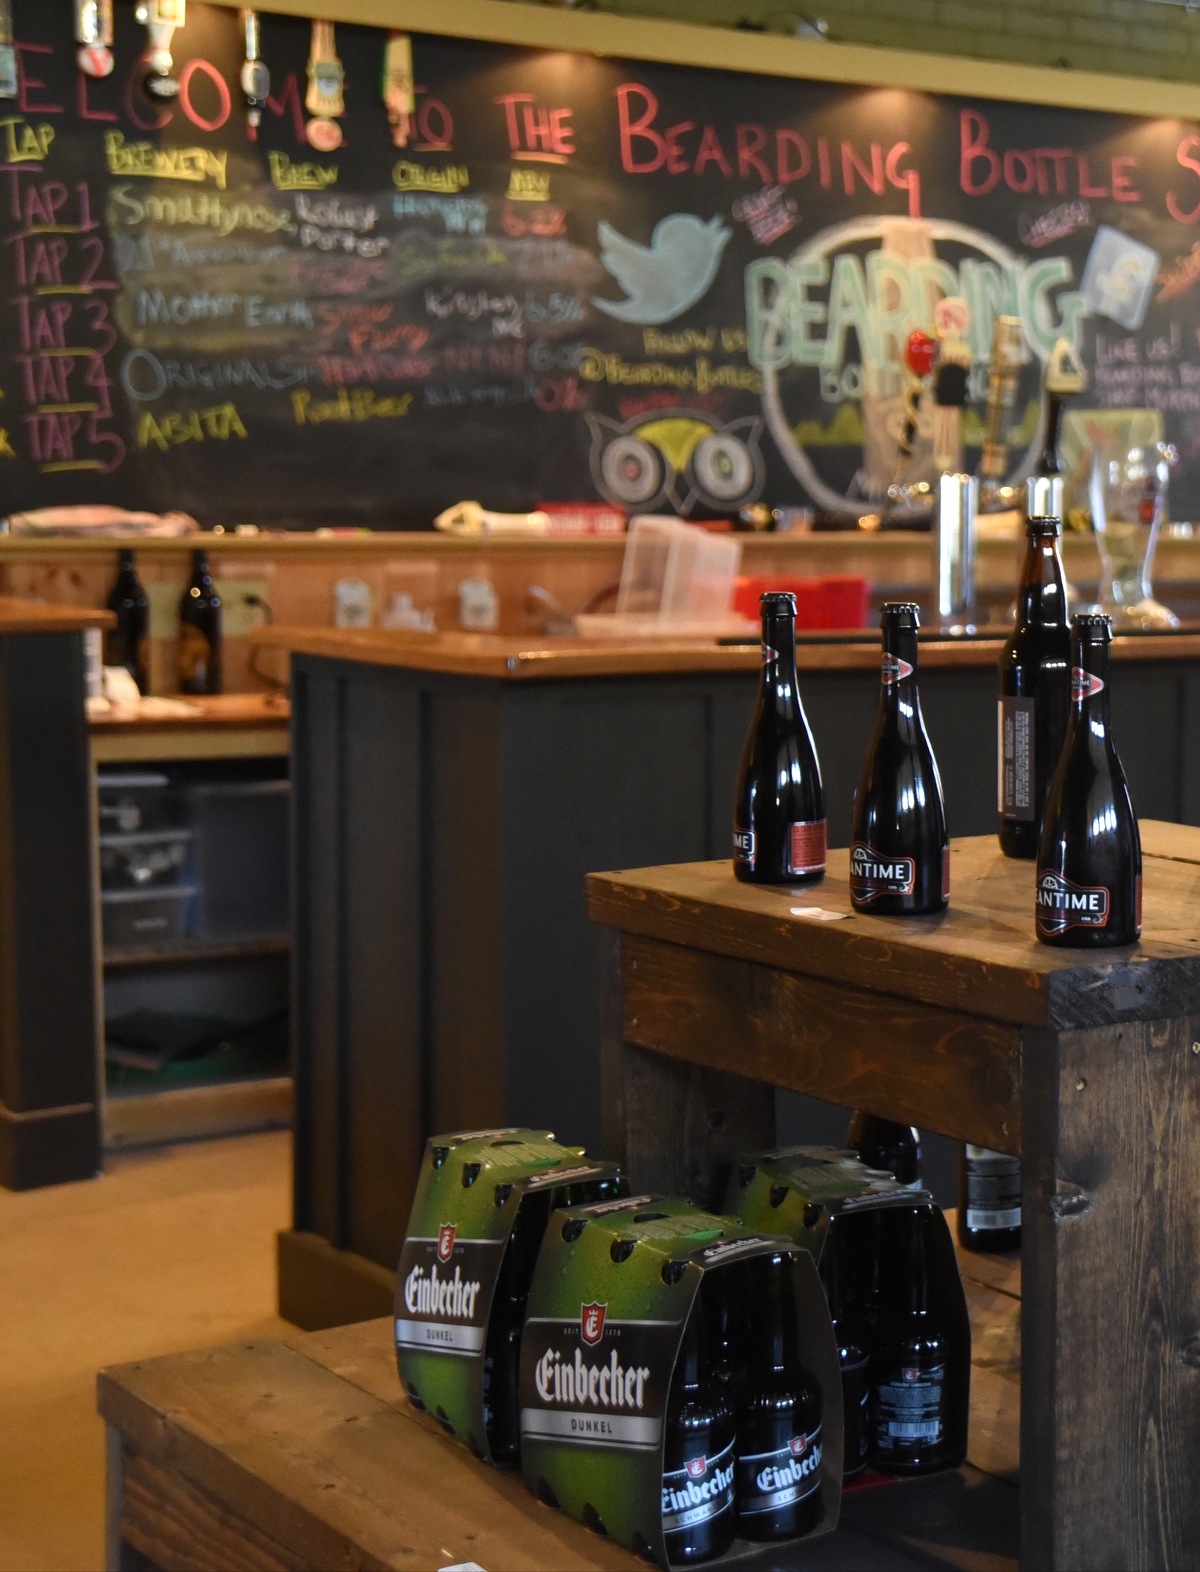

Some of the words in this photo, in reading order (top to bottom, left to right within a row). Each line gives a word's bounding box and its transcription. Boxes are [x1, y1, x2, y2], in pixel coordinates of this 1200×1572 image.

[0, 116, 55, 158] TAP
[105, 129, 227, 190] BREWERY
[497, 93, 575, 155] THE
[616, 83, 921, 218] BEARDING
[960, 110, 1141, 200] BOTTLE
[0, 164, 68, 225] TAP
[77, 181, 97, 231] 1
[5, 232, 68, 286] TAP
[81, 236, 119, 290] 2
[9, 295, 72, 348] TAP
[87, 301, 117, 357] 3
[14, 355, 75, 402] TAP
[86, 351, 113, 418] 4
[19, 413, 81, 459] TAP
[88, 413, 126, 472] 5
[137, 402, 248, 451] ABITA
[1036, 889, 1099, 910] ANTIME
[405, 1264, 480, 1319] Einbecker
[426, 1328, 453, 1341] DUNKEL
[535, 1347, 650, 1409] Einbecker
[571, 1418, 612, 1433] DUNKEL
